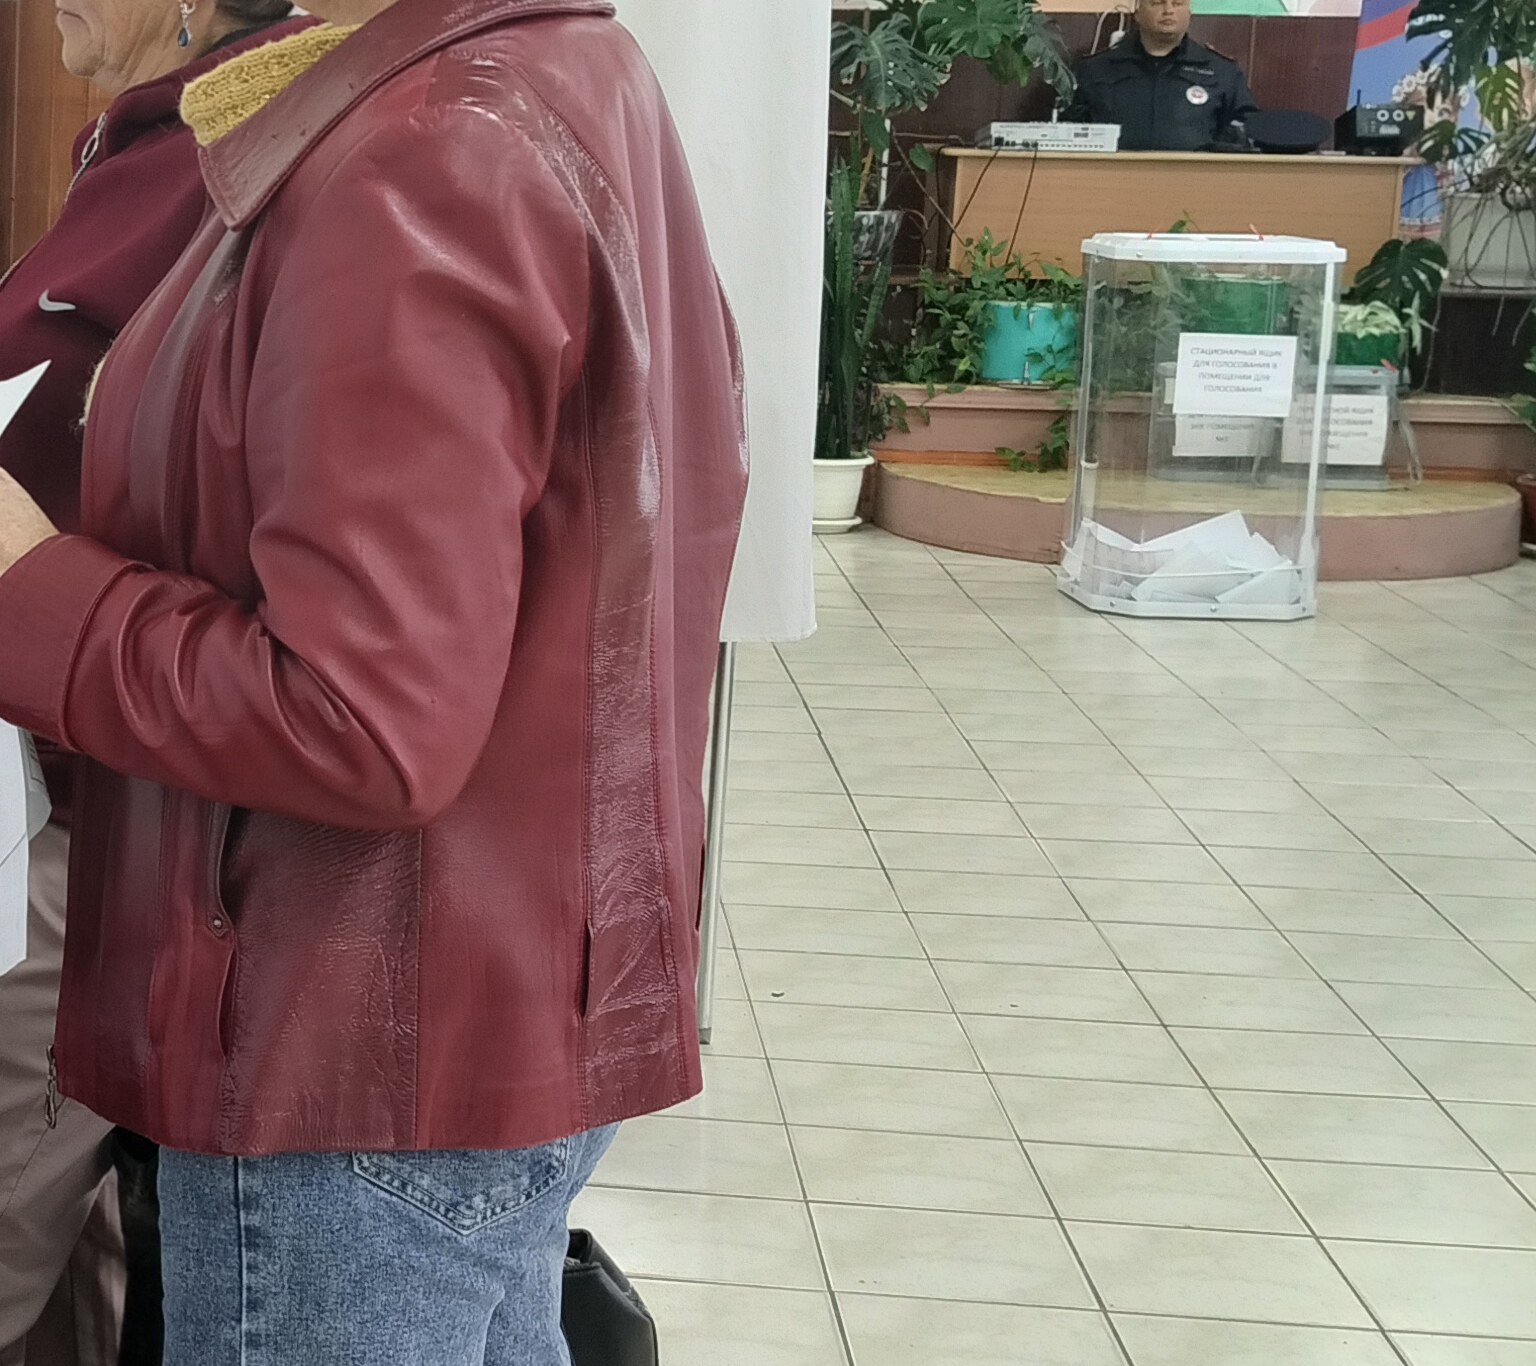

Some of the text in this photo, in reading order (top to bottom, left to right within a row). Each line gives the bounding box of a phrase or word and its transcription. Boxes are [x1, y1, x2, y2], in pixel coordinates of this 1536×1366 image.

[1190, 347, 1257, 357] СТАЦИОНАРНЫЙ
[1193, 360, 1210, 368] ДЛЯ
[1212, 361, 1270, 369] ГОЛОСОВАНИЯ
[1204, 385, 1262, 393] ГОЛОСОВАНИЯ
